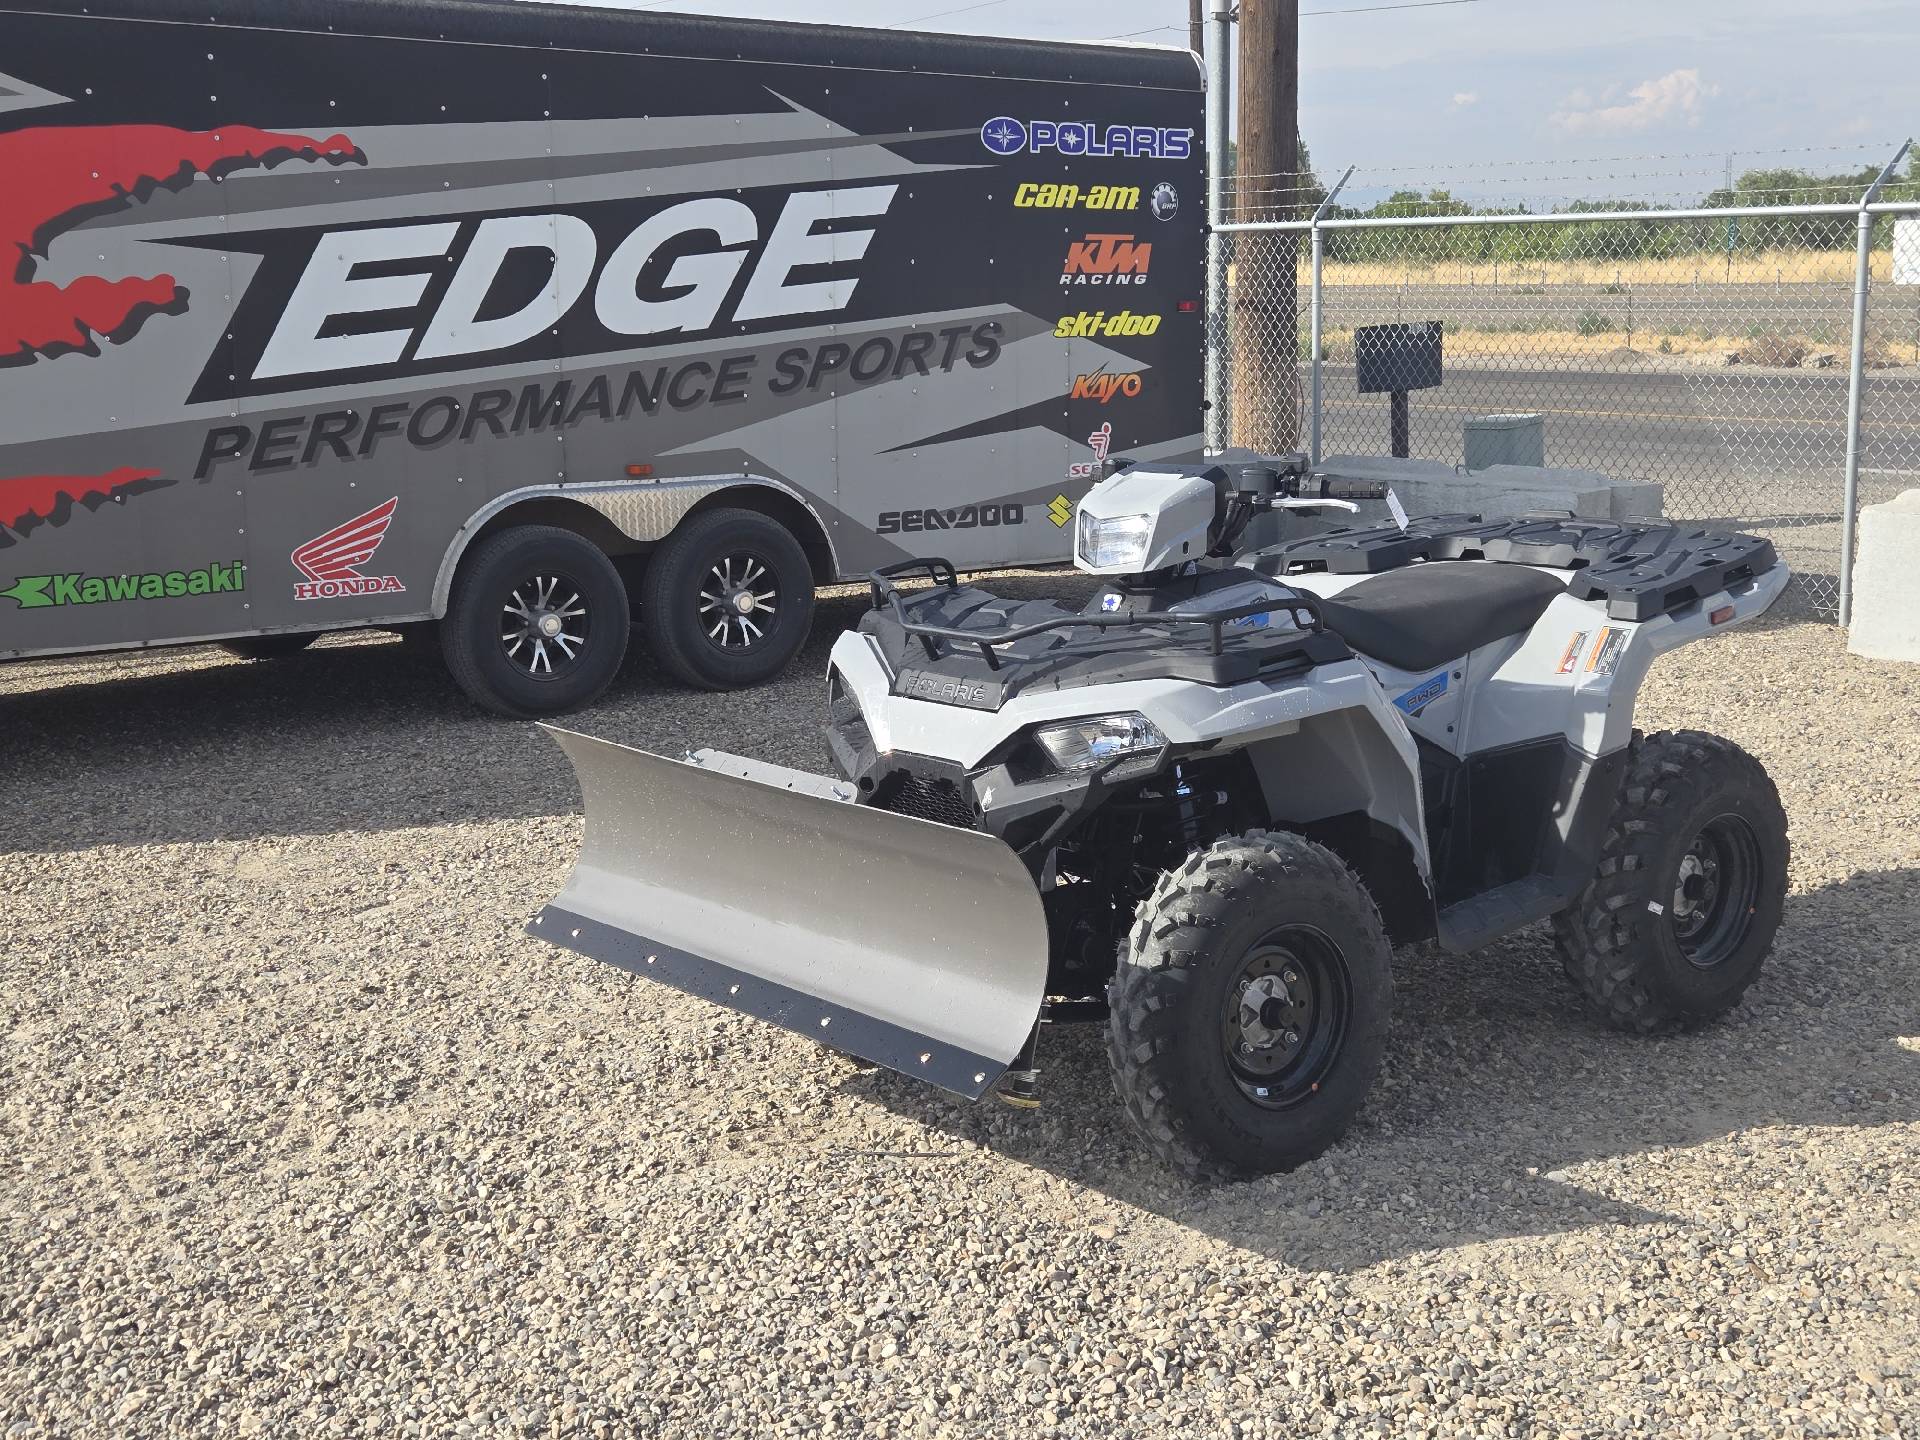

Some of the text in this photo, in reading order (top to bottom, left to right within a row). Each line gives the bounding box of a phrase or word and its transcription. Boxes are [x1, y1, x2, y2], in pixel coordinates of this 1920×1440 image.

[1030, 121, 1191, 159] POLARIS
[1013, 183, 1140, 210] can-am
[1063, 234, 1152, 274] KTM
[250, 185, 899, 380] EDGE
[1059, 274, 1147, 285] RACING
[1053, 311, 1162, 338] ski-doo
[193, 322, 1005, 481] PERFORMANCE SPORTS
[1070, 366, 1142, 403] KAYO
[53, 560, 246, 606] Kawasaki
[294, 575, 406, 600] HONDA
[905, 675, 985, 701] POLARIS
